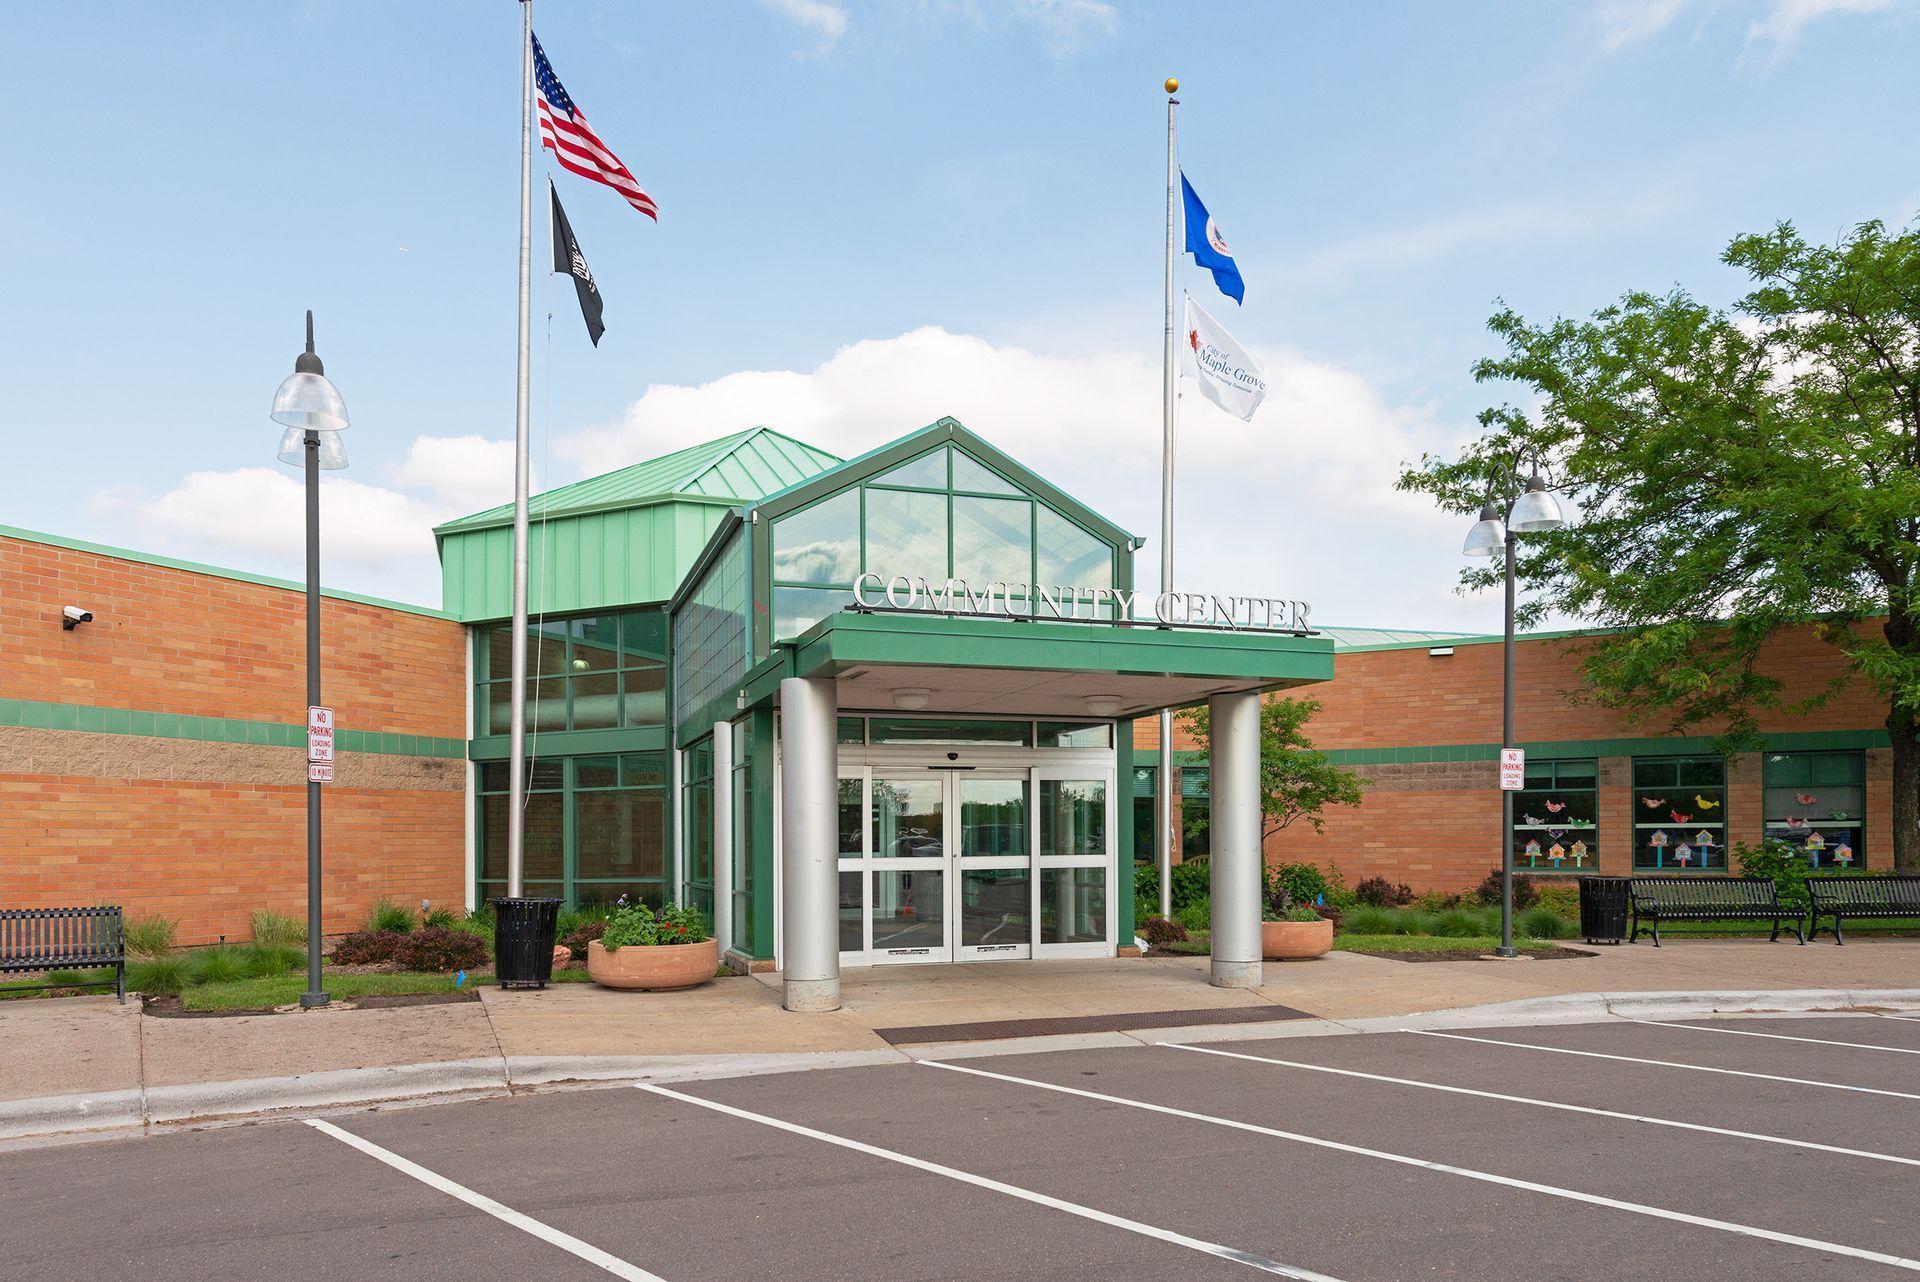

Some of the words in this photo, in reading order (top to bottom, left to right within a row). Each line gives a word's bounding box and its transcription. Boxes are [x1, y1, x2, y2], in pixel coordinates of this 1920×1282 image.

[1220, 352, 1231, 361] of
[1200, 349, 1232, 375] Maple
[1234, 367, 1266, 390] Grove
[853, 571, 1140, 622] COMMUNITY
[1155, 591, 1312, 632] CENTER
[317, 712, 327, 724] NO
[310, 725, 332, 737] PARKING
[311, 739, 331, 748] LOADING
[315, 748, 328, 757] ZONE
[1508, 753, 1517, 761] NO
[1502, 763, 1522, 771] PARKING
